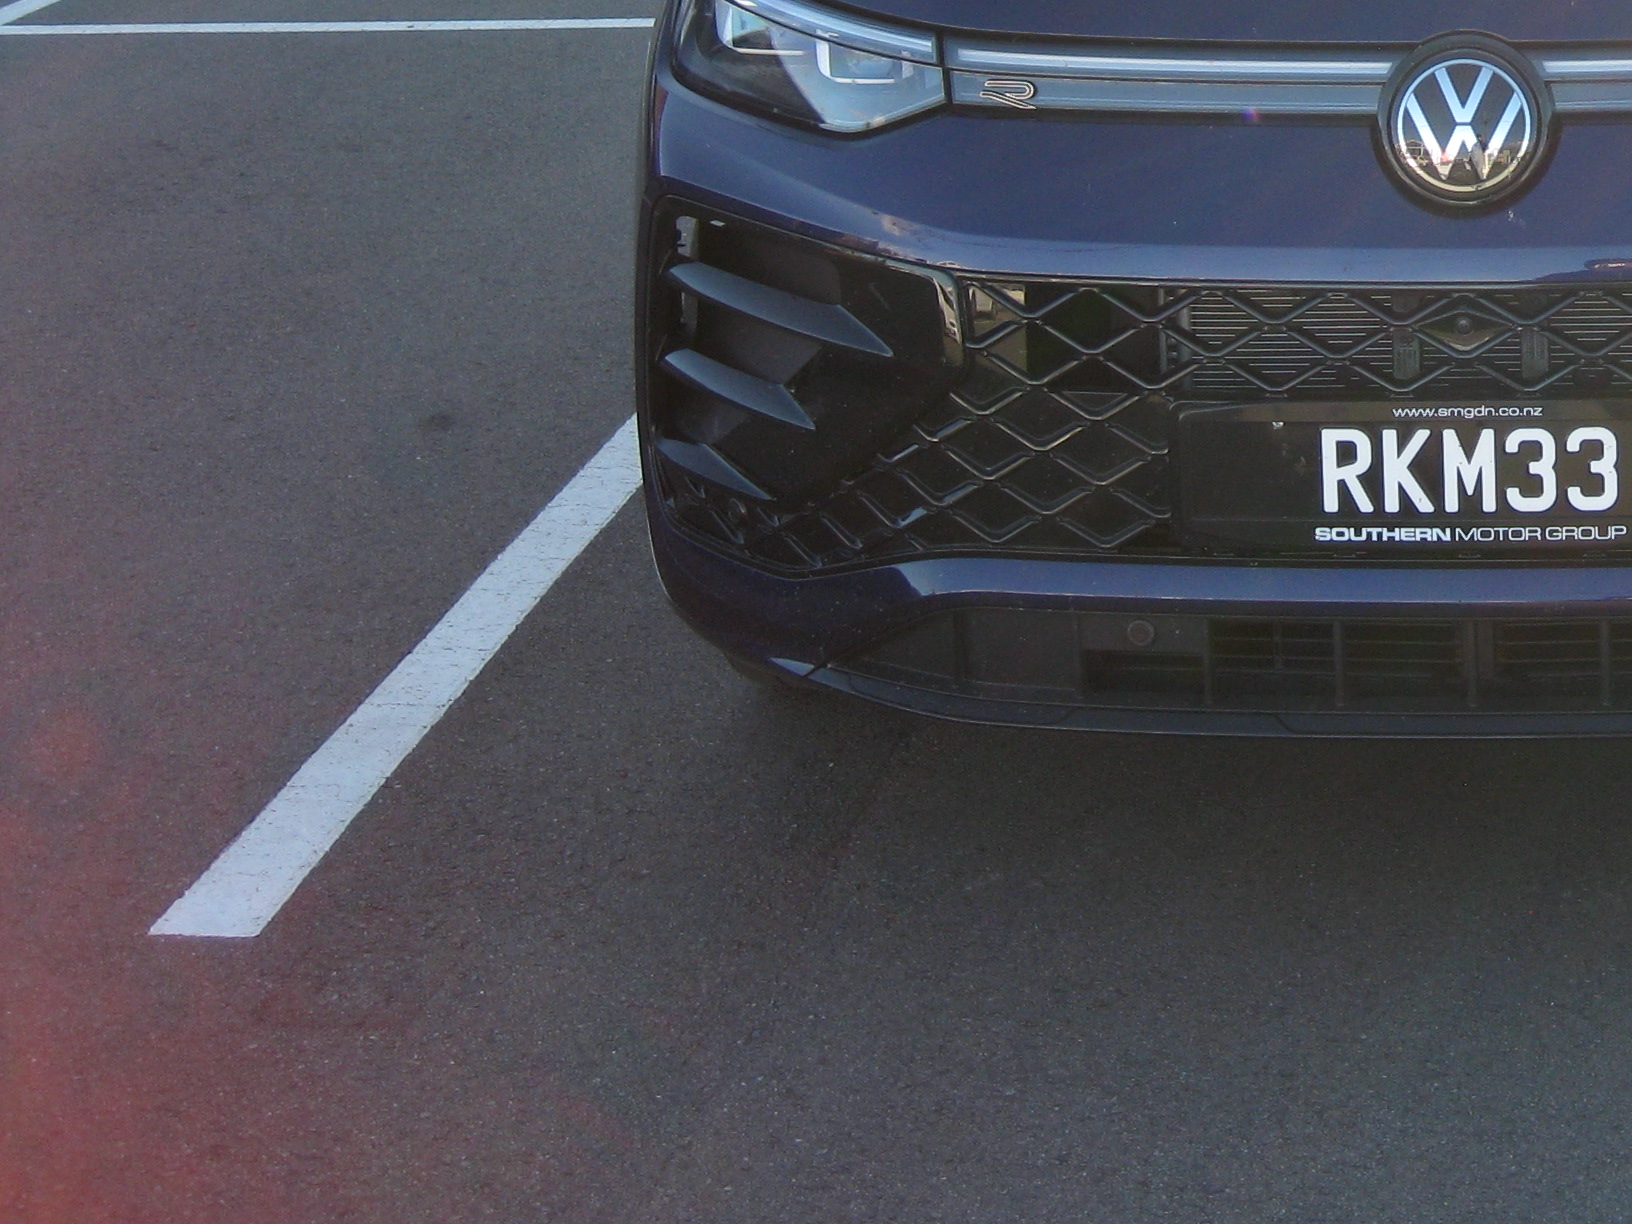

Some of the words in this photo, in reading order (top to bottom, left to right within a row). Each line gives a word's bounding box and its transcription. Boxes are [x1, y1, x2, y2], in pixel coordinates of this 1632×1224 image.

[1392, 405, 1543, 419] www.smgdn.co.nz
[1320, 427, 1618, 513] RKM33
[1314, 526, 1452, 542] SOUTHERN
[1455, 526, 1542, 542] MOTOR
[1545, 525, 1627, 541] GROUP
